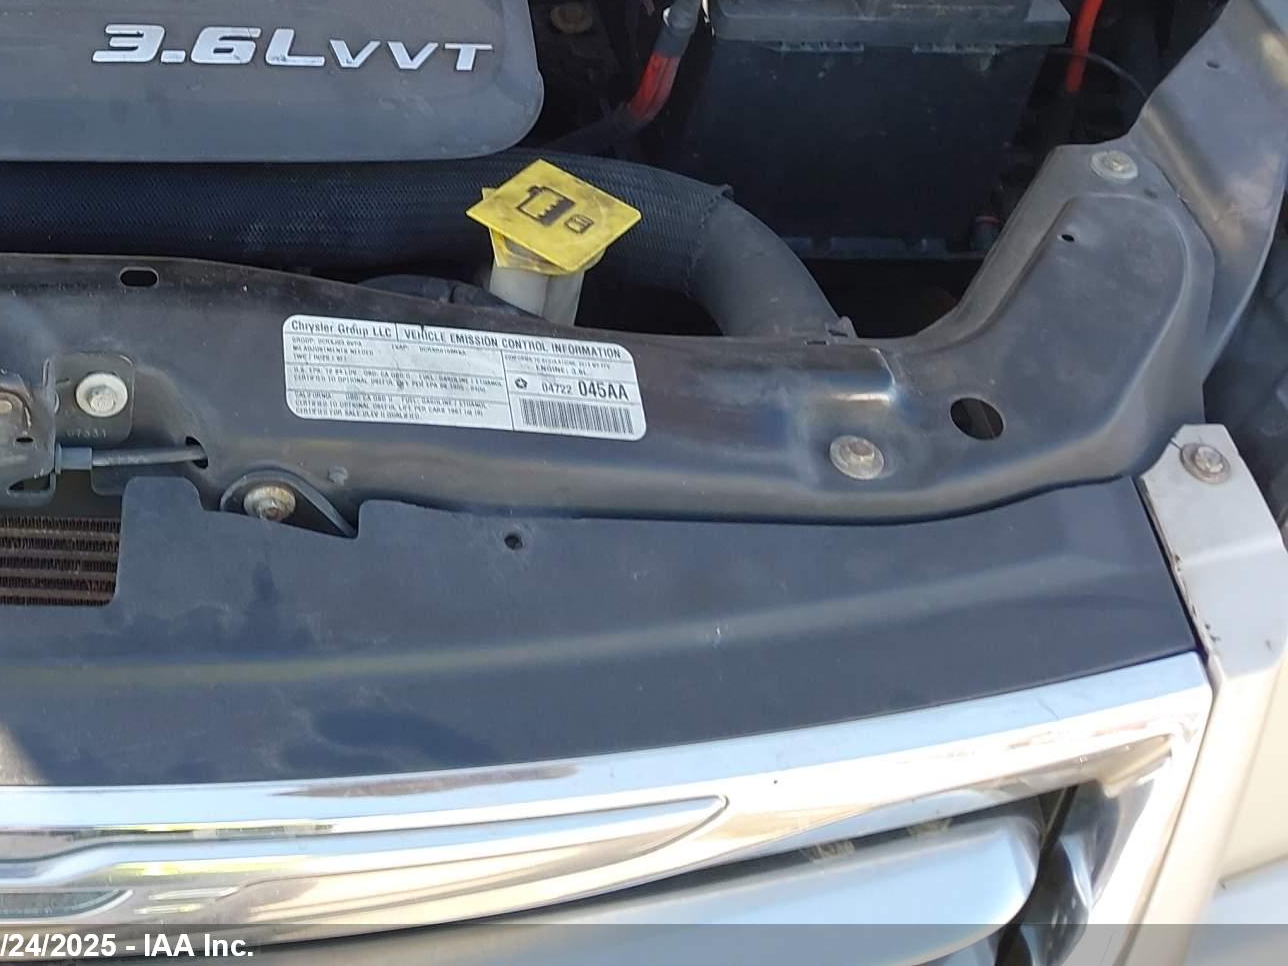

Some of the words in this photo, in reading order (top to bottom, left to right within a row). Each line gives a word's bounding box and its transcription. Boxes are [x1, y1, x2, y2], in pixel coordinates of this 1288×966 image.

[92, 24, 325, 67] 3.6L
[330, 38, 493, 71] VVT
[292, 320, 334, 334] Chrysler
[337, 323, 369, 338] Group
[373, 327, 392, 338] LLC
[404, 329, 446, 342] VEHICLE
[449, 333, 499, 348] EMISSION
[501, 337, 548, 352] CONTROL
[551, 343, 621, 359] INFORMATION
[542, 383, 573, 395] 04722
[578, 380, 630, 401] 045AA
